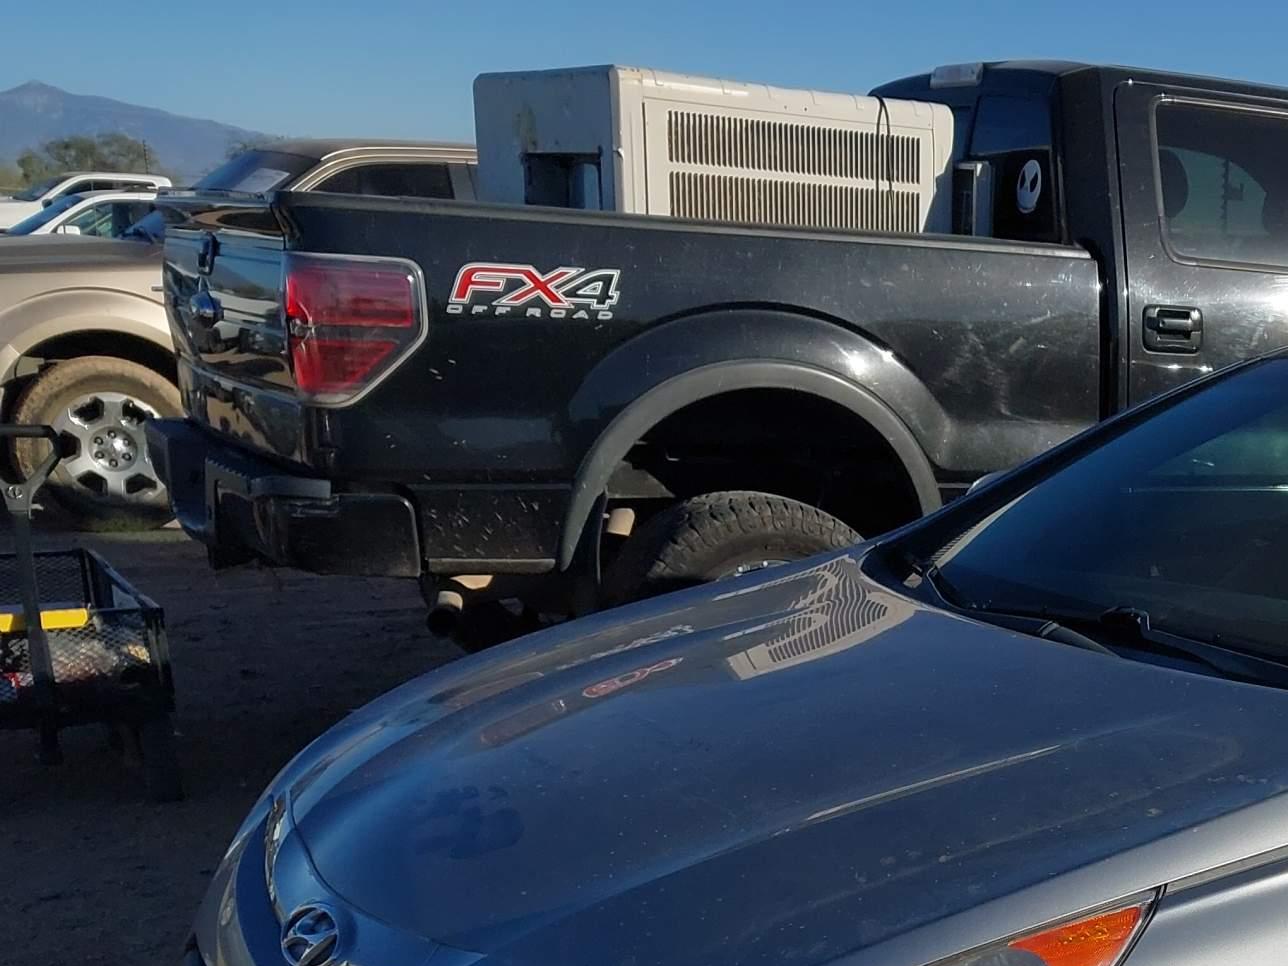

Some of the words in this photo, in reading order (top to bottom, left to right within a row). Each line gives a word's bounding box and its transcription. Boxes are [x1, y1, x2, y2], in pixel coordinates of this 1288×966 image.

[449, 262, 620, 309] FX4
[446, 304, 512, 316] OFF
[526, 307, 613, 320] ROAD
